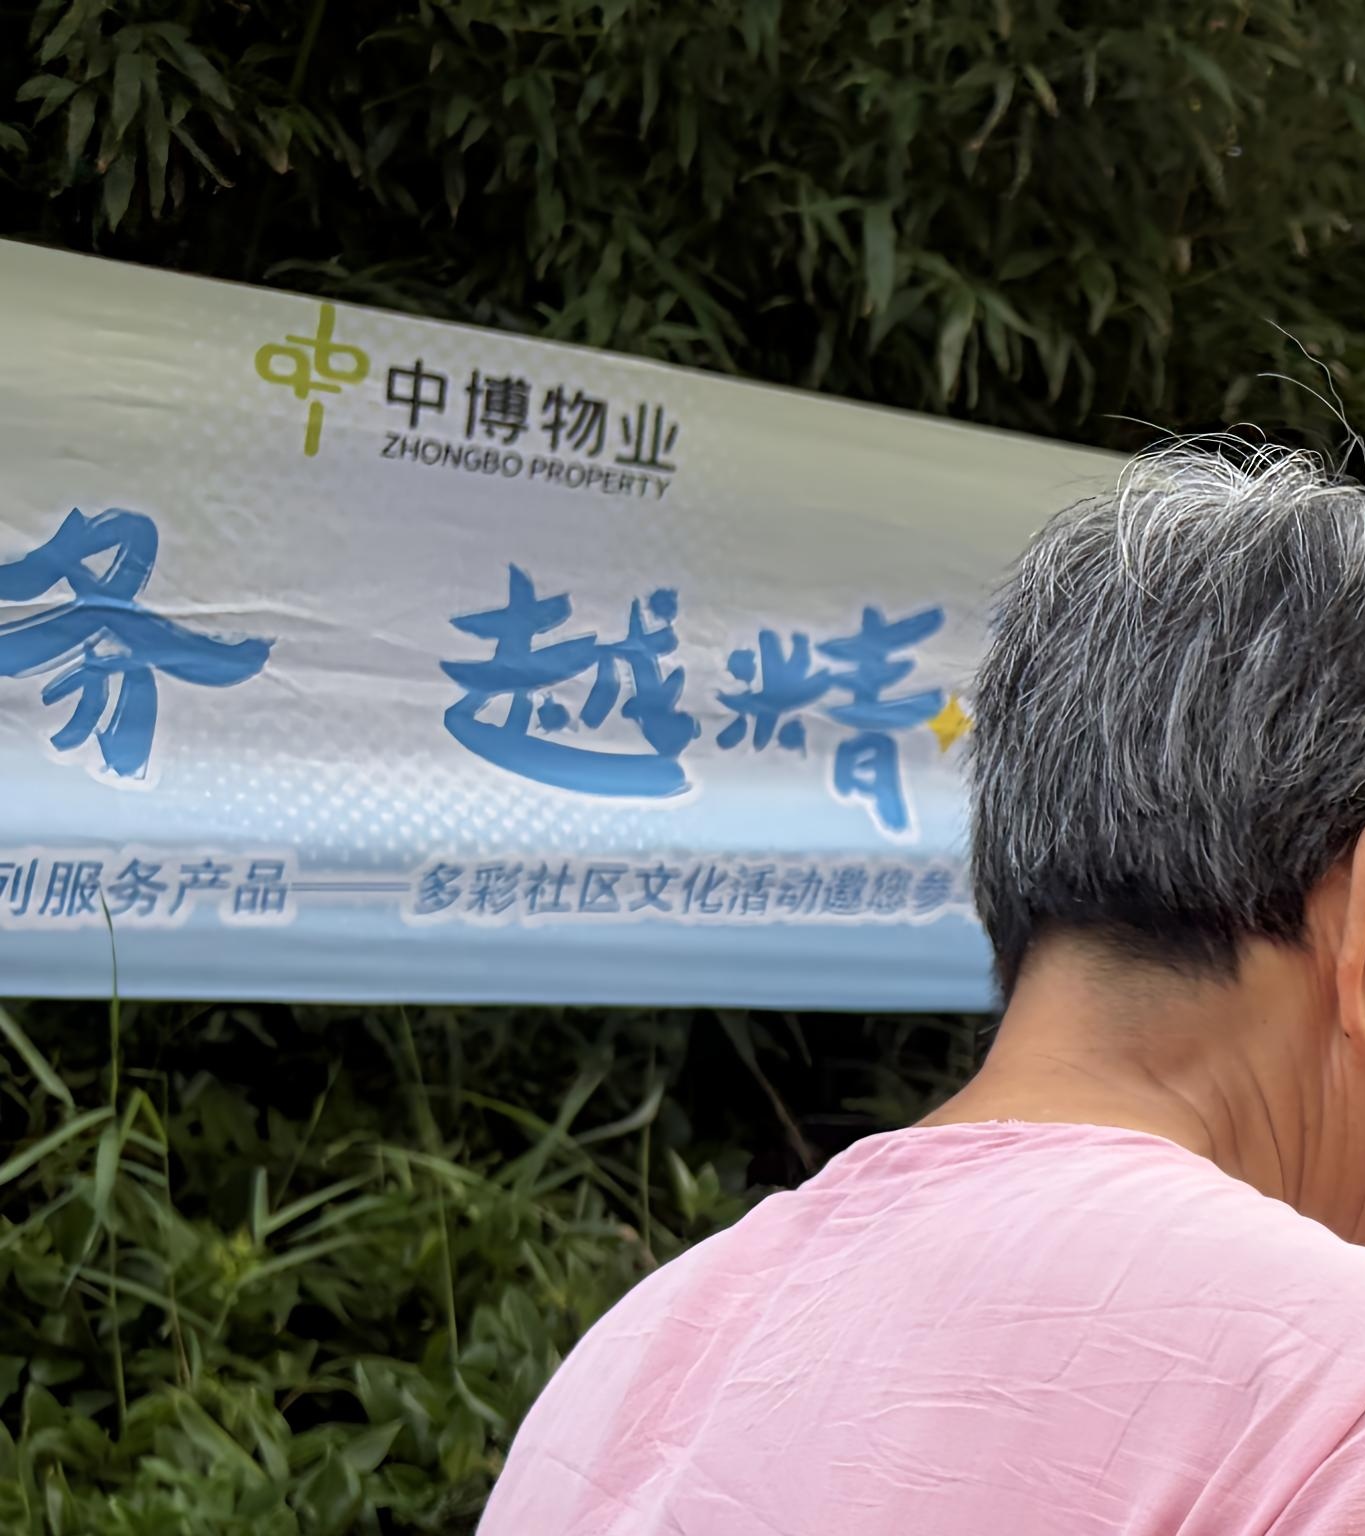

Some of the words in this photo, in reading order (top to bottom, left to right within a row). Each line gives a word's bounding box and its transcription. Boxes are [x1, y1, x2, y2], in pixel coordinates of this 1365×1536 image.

[385, 358, 679, 473] 中博物业
[380, 430, 524, 478] ZHONGBO
[528, 457, 672, 500] PROPERTY
